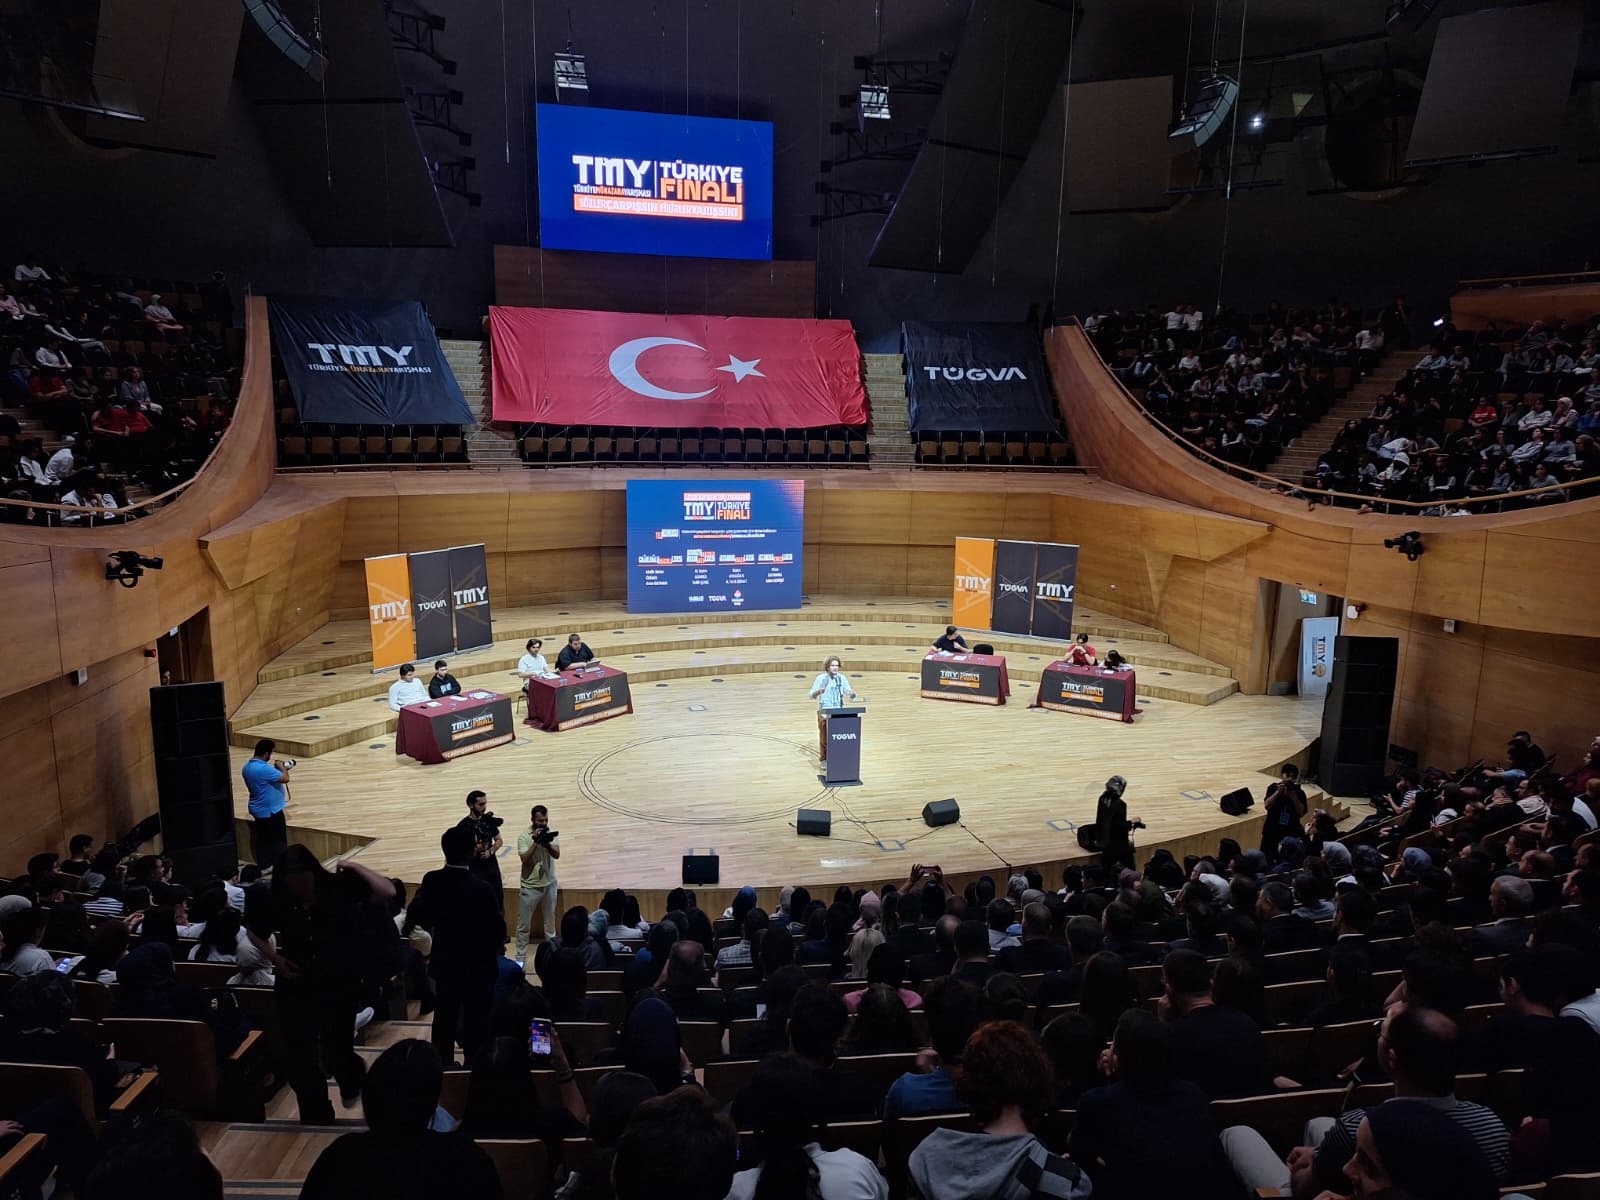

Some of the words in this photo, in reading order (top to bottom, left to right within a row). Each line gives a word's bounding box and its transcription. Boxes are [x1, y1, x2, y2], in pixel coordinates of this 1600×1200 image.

[572, 155, 651, 188] TMY
[307, 343, 413, 366] TMY
[684, 501, 714, 516] TMY
[956, 575, 991, 590] TMY
[1037, 582, 1074, 598] TMY
[454, 586, 487, 605] TMY
[370, 599, 409, 620] TMY
[1317, 636, 1326, 662] TMY
